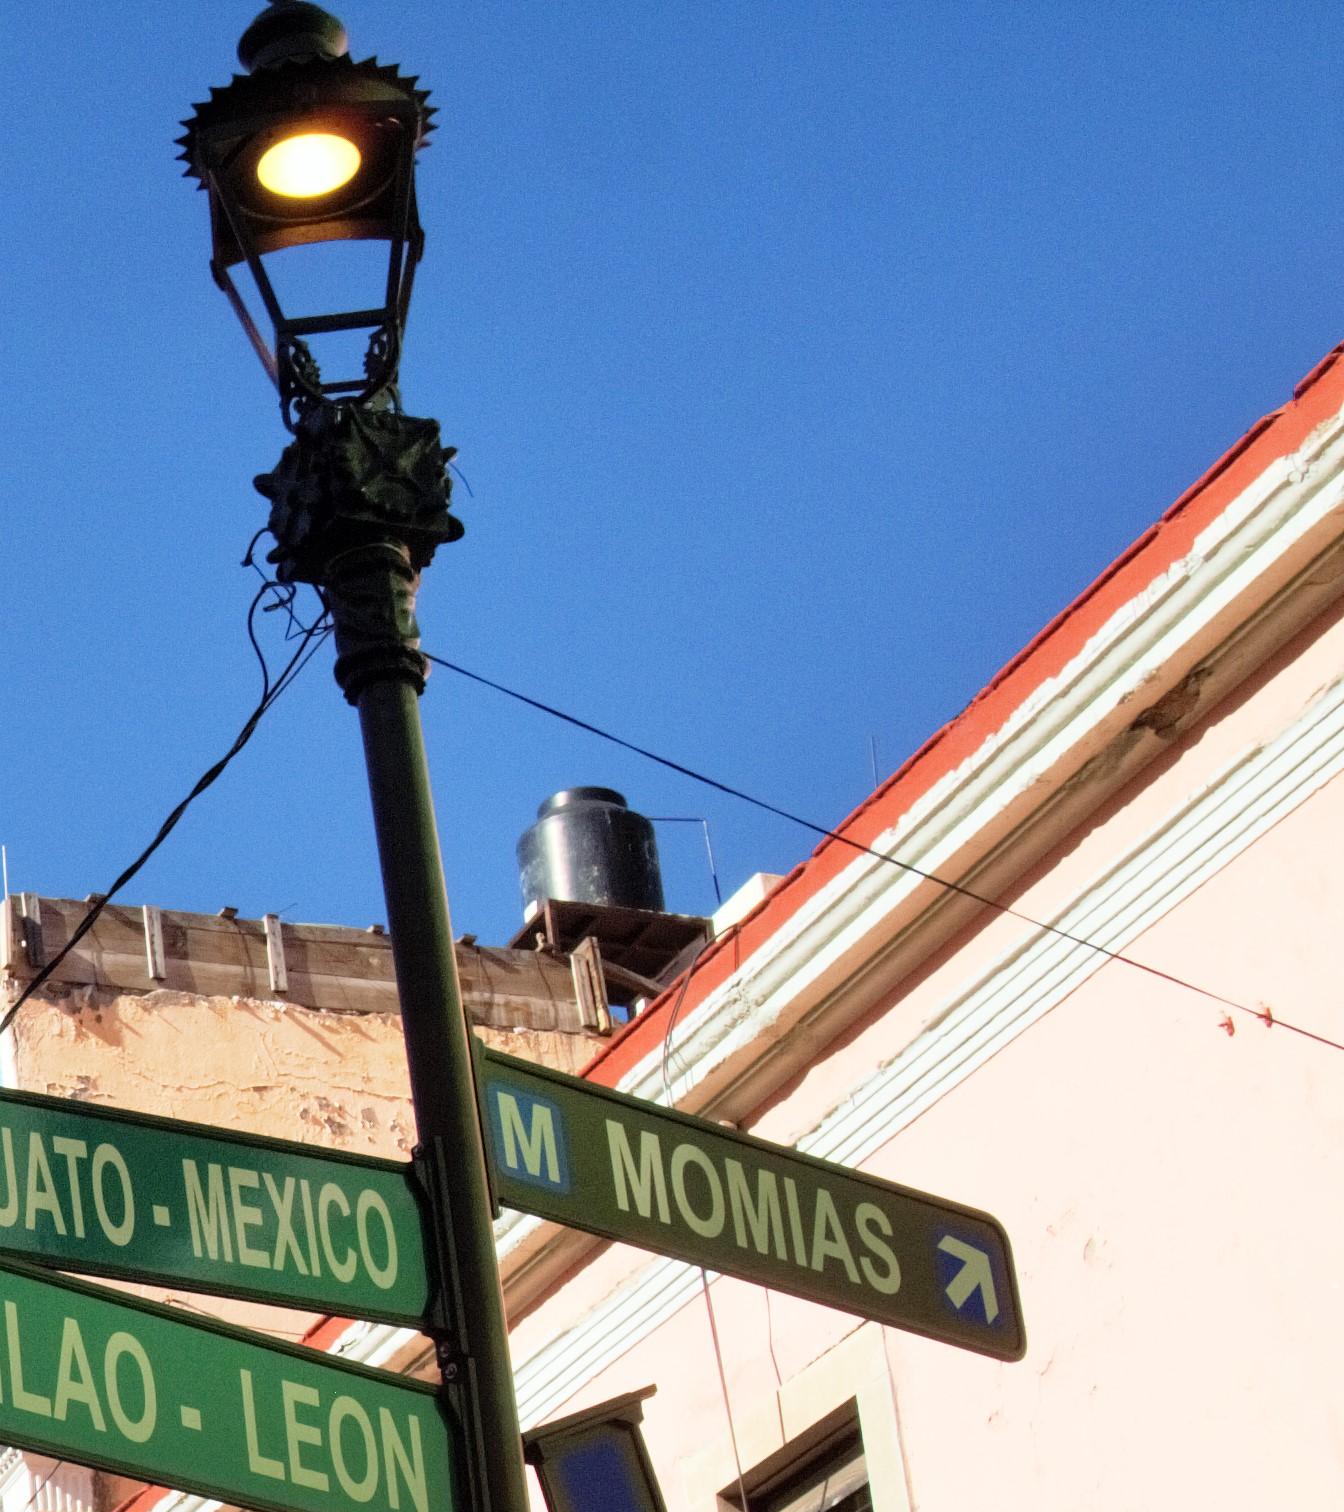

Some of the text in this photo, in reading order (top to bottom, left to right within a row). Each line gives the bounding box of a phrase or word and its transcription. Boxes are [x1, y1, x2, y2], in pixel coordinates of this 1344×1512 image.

[182, 1158, 398, 1290] MEXICO
[496, 1090, 902, 1296] M MOMIAS
